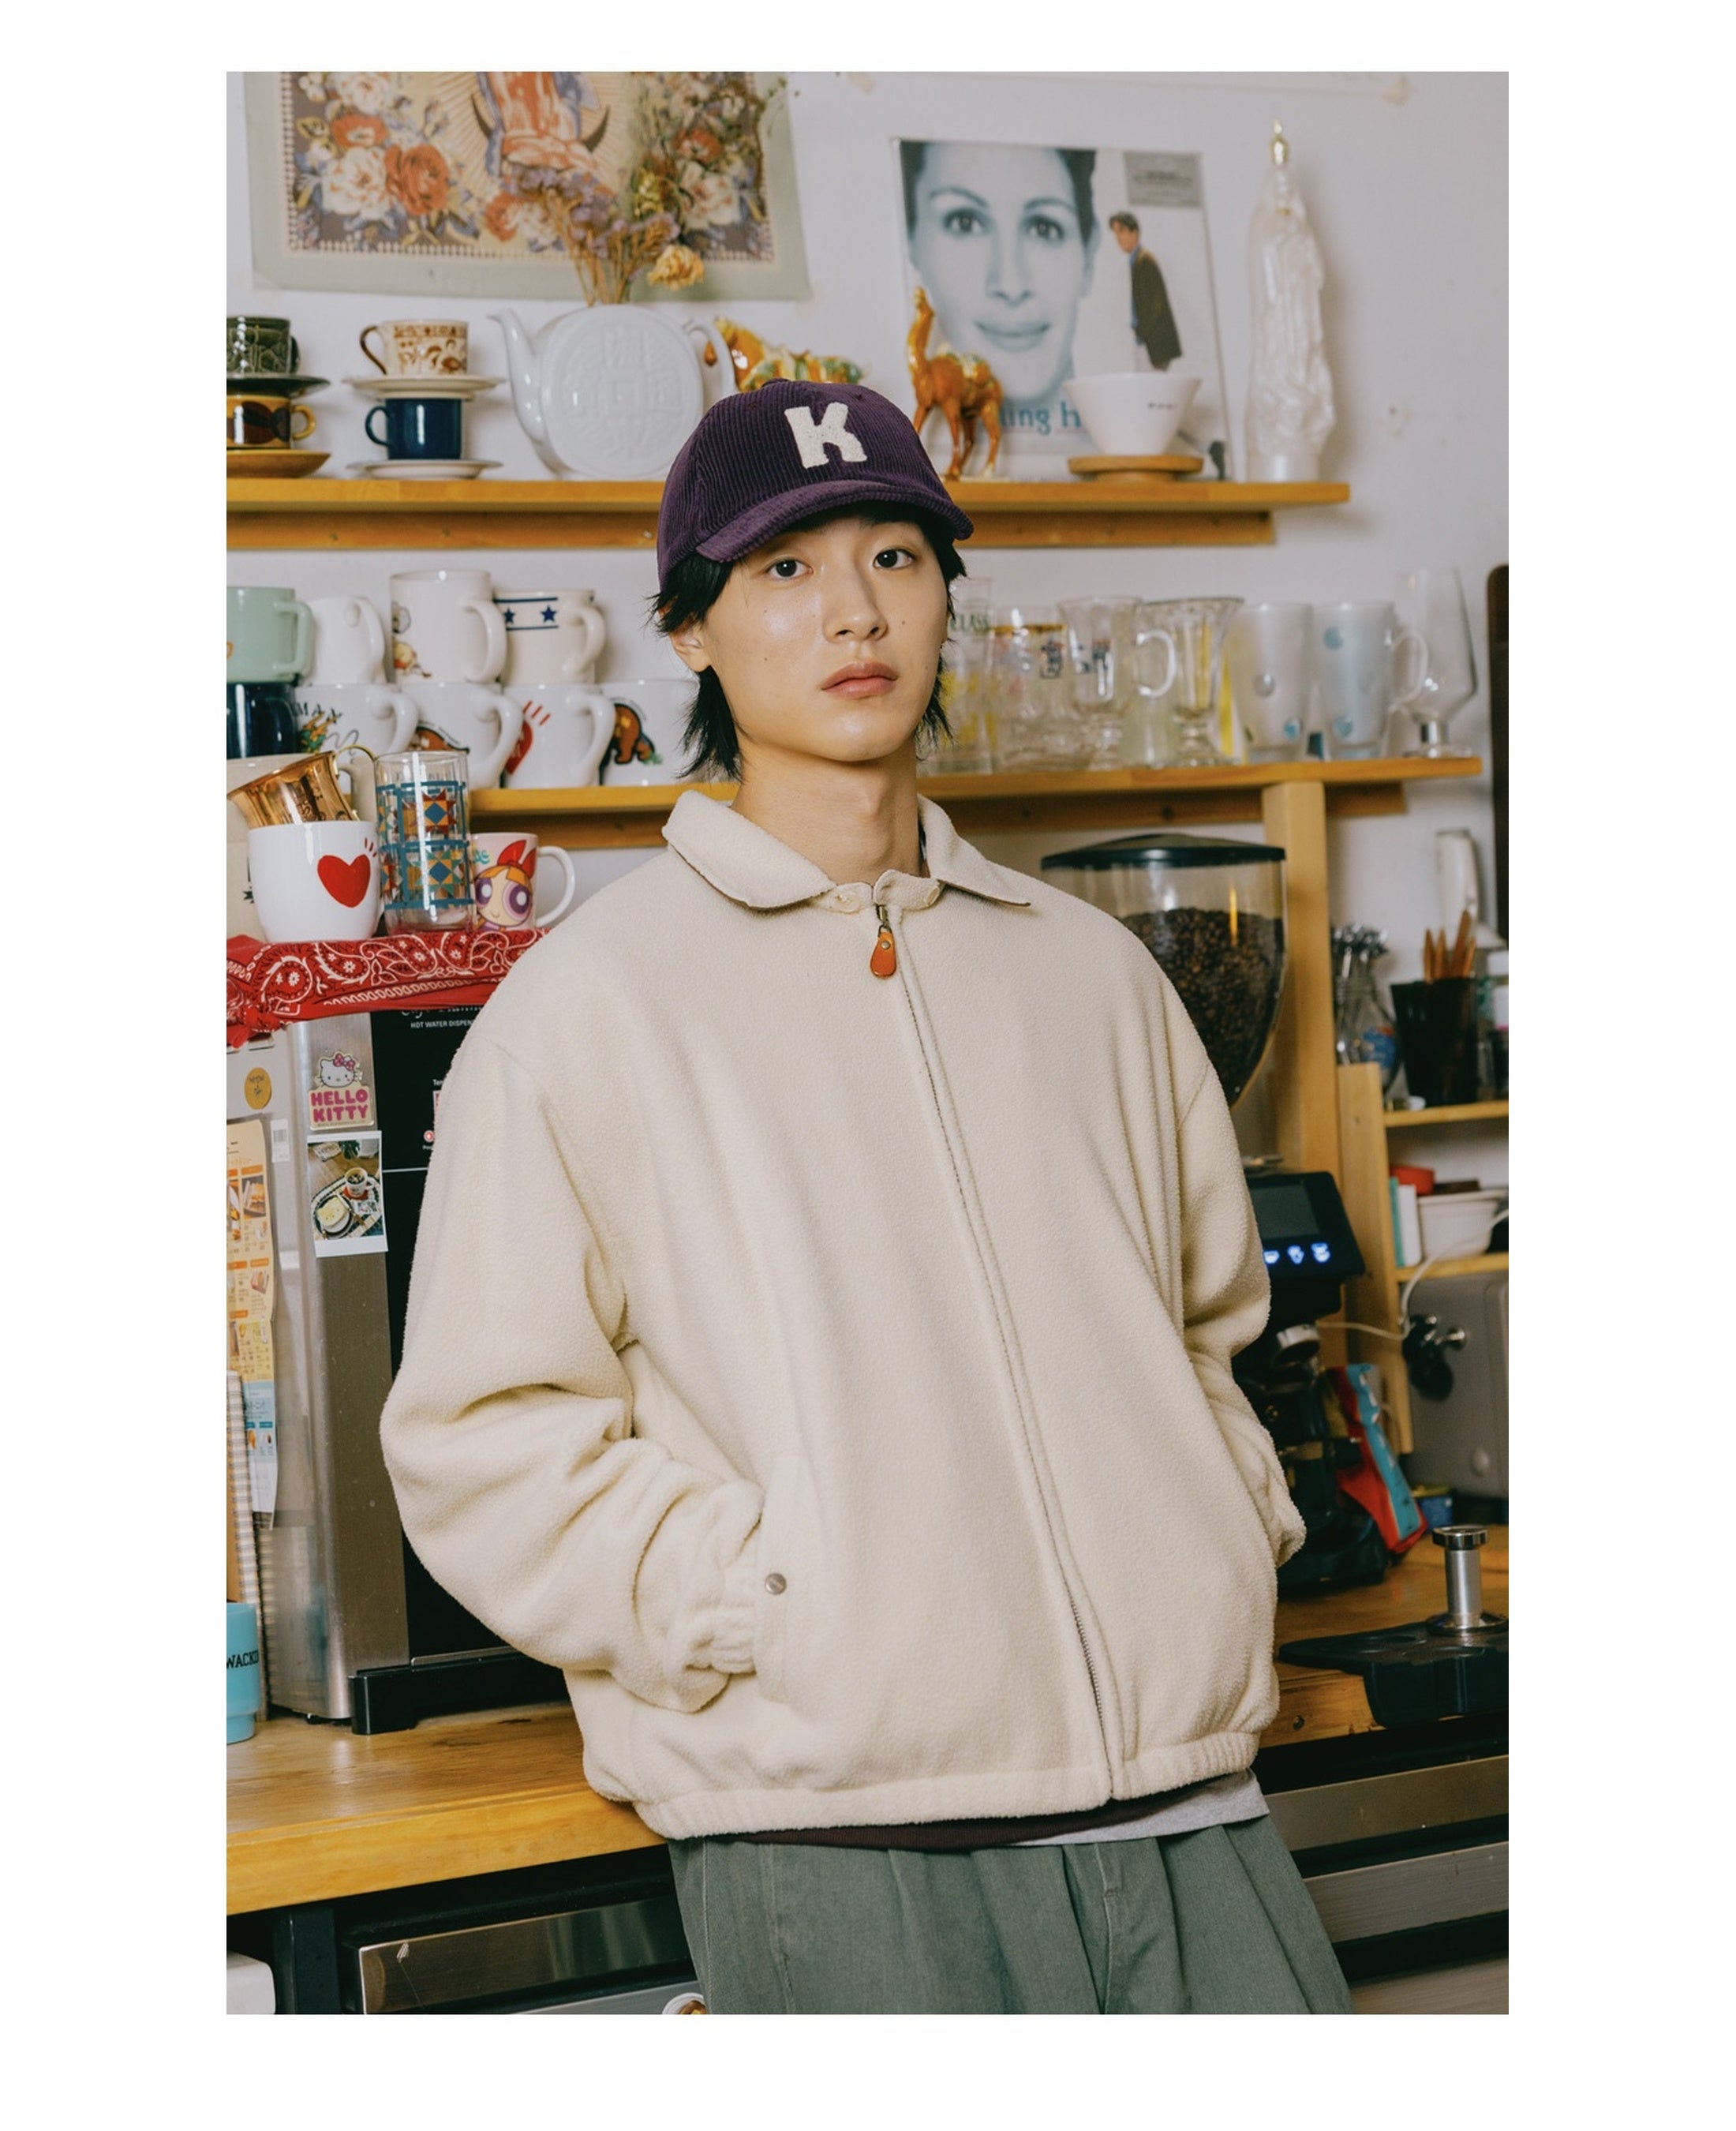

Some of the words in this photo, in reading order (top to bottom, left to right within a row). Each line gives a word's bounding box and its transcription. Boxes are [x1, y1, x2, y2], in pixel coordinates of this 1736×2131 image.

[784, 402, 867, 469] K
[311, 1089, 368, 1107] HELLO
[313, 1104, 368, 1122] KITTY
